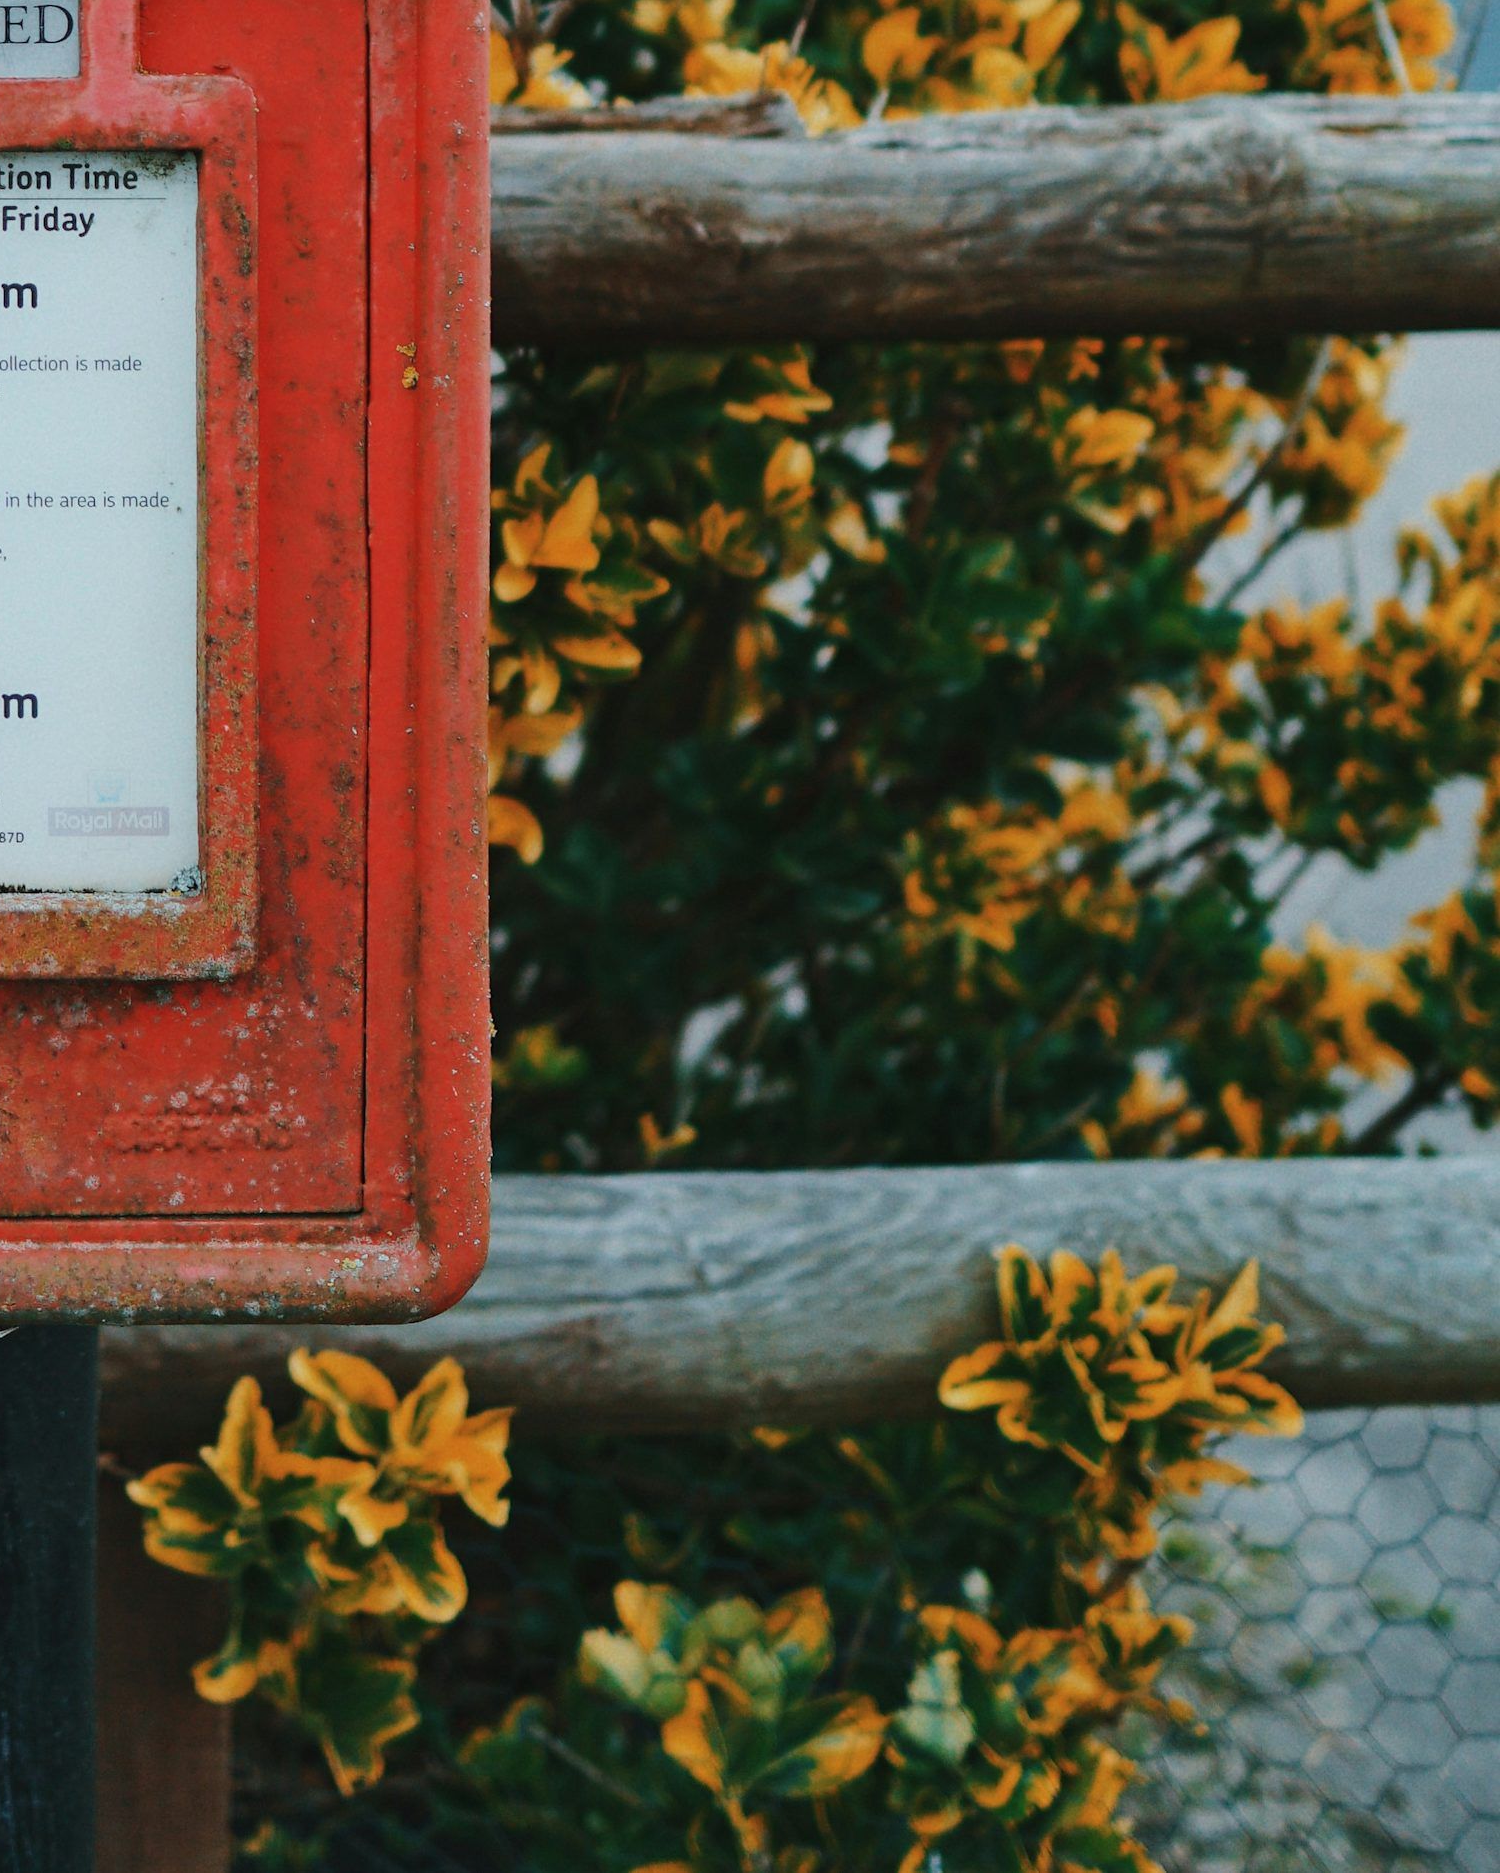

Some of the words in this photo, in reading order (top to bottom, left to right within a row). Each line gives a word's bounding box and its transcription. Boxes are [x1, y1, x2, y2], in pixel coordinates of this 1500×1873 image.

[62, 164, 139, 190] Time
[2, 205, 95, 237] Friday
[76, 355, 88, 372] is
[94, 355, 142, 372] made
[6, 492, 19, 508] in
[27, 492, 54, 508] the
[60, 496, 96, 508] area
[103, 491, 115, 508] is
[122, 491, 170, 508] made
[54, 810, 112, 833] Royal
[117, 810, 163, 830] Mail
